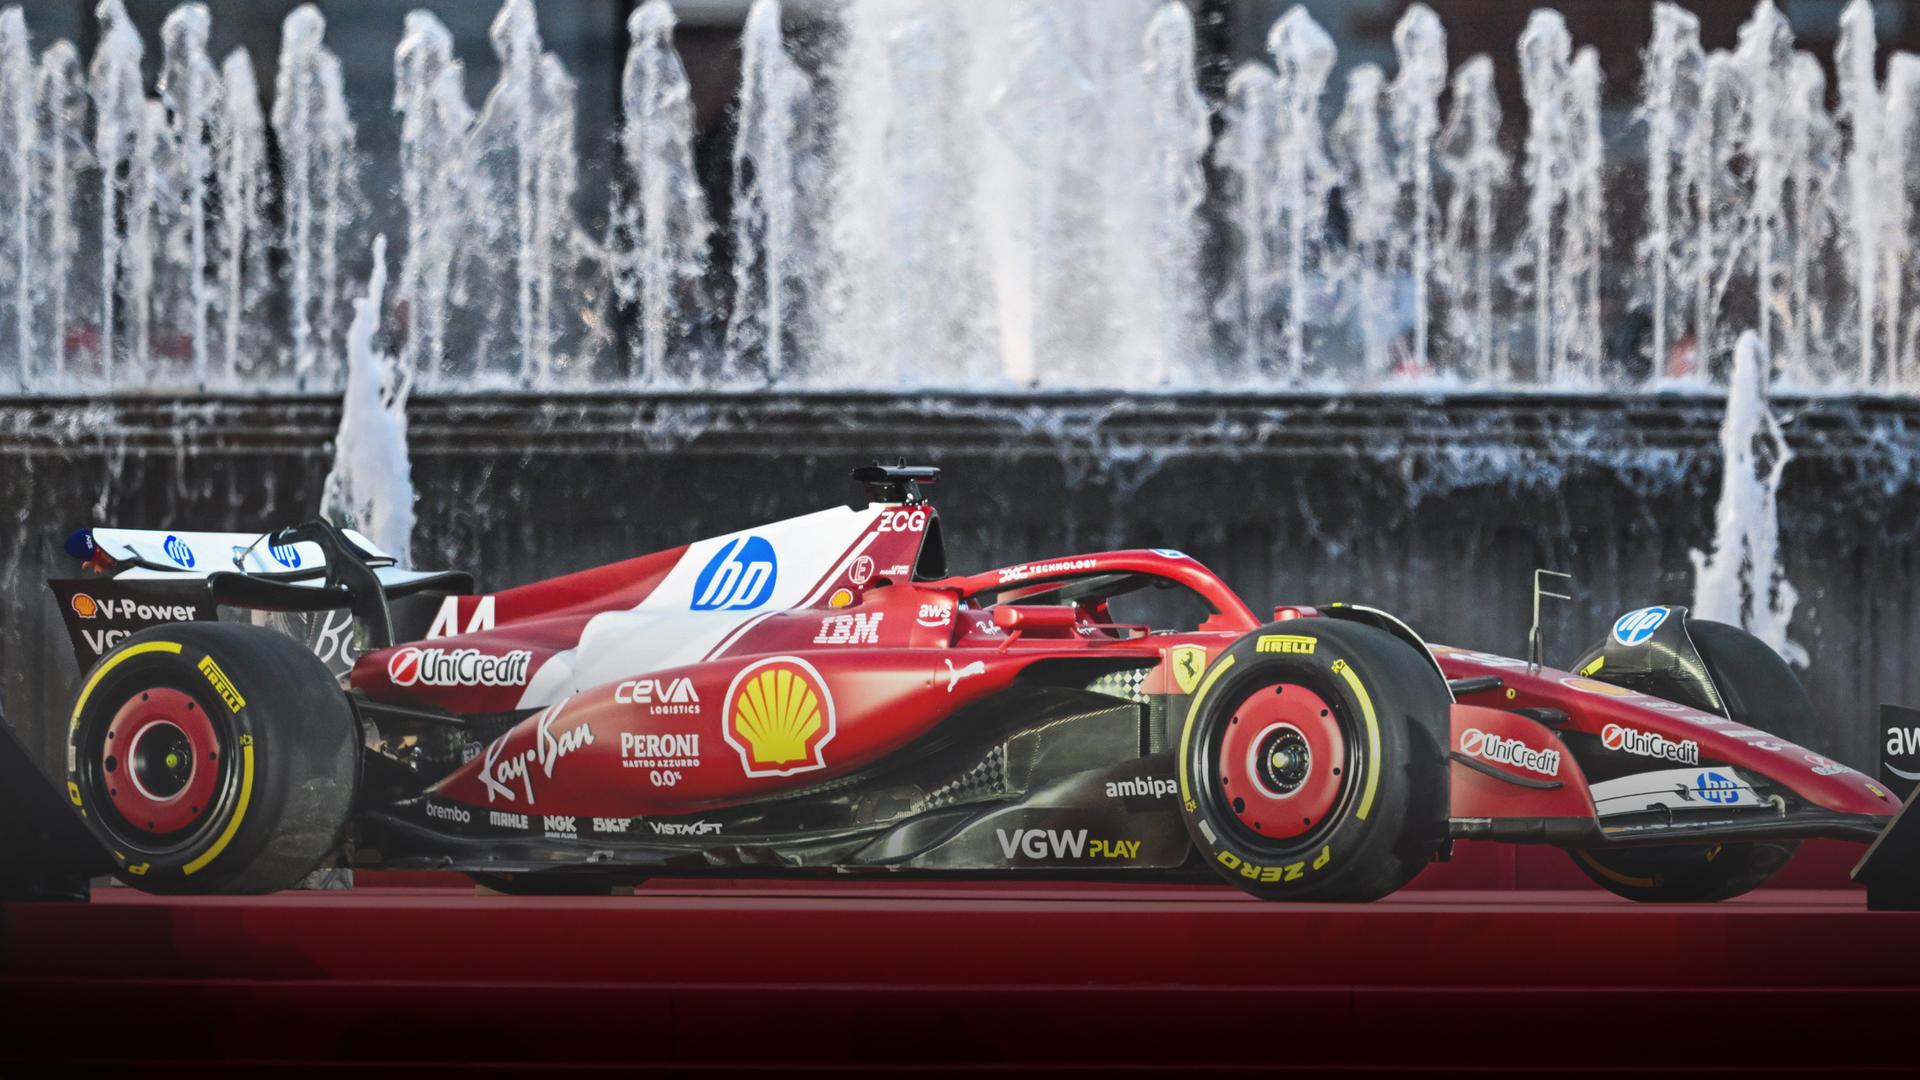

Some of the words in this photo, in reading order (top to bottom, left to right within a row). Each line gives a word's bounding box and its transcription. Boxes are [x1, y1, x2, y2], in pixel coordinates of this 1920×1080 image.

[877, 510, 925, 532] ZCG
[694, 536, 774, 611] hp
[1029, 559, 1097, 574] TECHNOLOGY
[97, 599, 196, 621] V-Power
[918, 604, 951, 619] aws
[813, 612, 884, 644] IBM
[1617, 607, 1665, 645] hp
[82, 629, 132, 655] VG
[1255, 634, 1318, 655] PIRELLI
[419, 649, 532, 685] UniCredit
[198, 655, 247, 714] PIRELLI
[650, 705, 700, 715] LOGISTICS
[620, 732, 699, 757] PERONI
[1484, 731, 1560, 777] UniCredit
[1623, 730, 1699, 766] UniCredit
[1886, 727, 1920, 756] aw
[657, 759, 700, 767] AZZURRO
[650, 770, 682, 787] 0.0%
[1105, 777, 1177, 799] ambipa
[426, 802, 470, 823] brembo
[490, 811, 528, 829] MAHLE
[543, 815, 577, 832] NGK
[996, 828, 1089, 859] VGW
[1089, 840, 1141, 859] PLAY
[1217, 850, 1305, 882] ZERO
[1305, 845, 1331, 870] P
